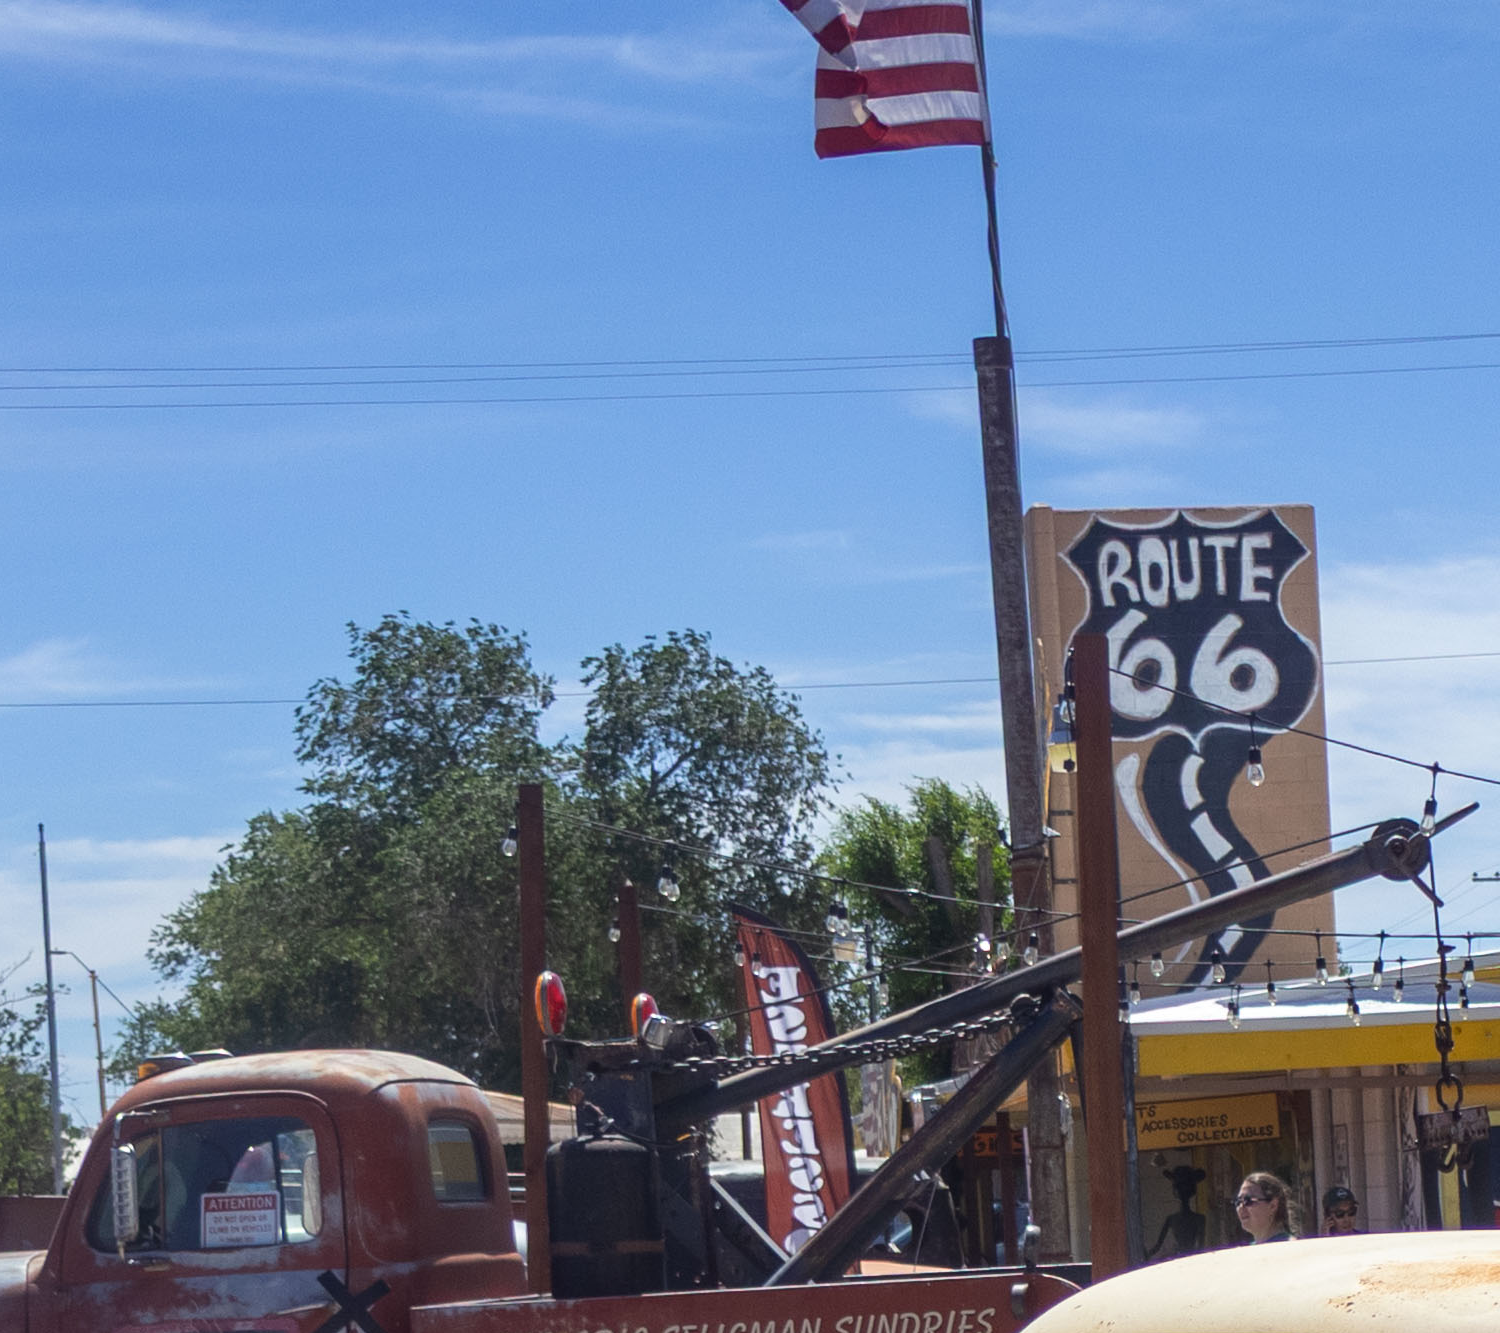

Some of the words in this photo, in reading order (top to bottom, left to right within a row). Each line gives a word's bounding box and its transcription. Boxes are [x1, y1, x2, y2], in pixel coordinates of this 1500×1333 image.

[1099, 532, 1273, 608] ROUTE
[1106, 608, 1280, 722] 66
[1141, 1114, 1229, 1134] ACCESSORIES
[1177, 1125, 1274, 1144] COLLECTABLES
[209, 1196, 274, 1210] ATTENTION
